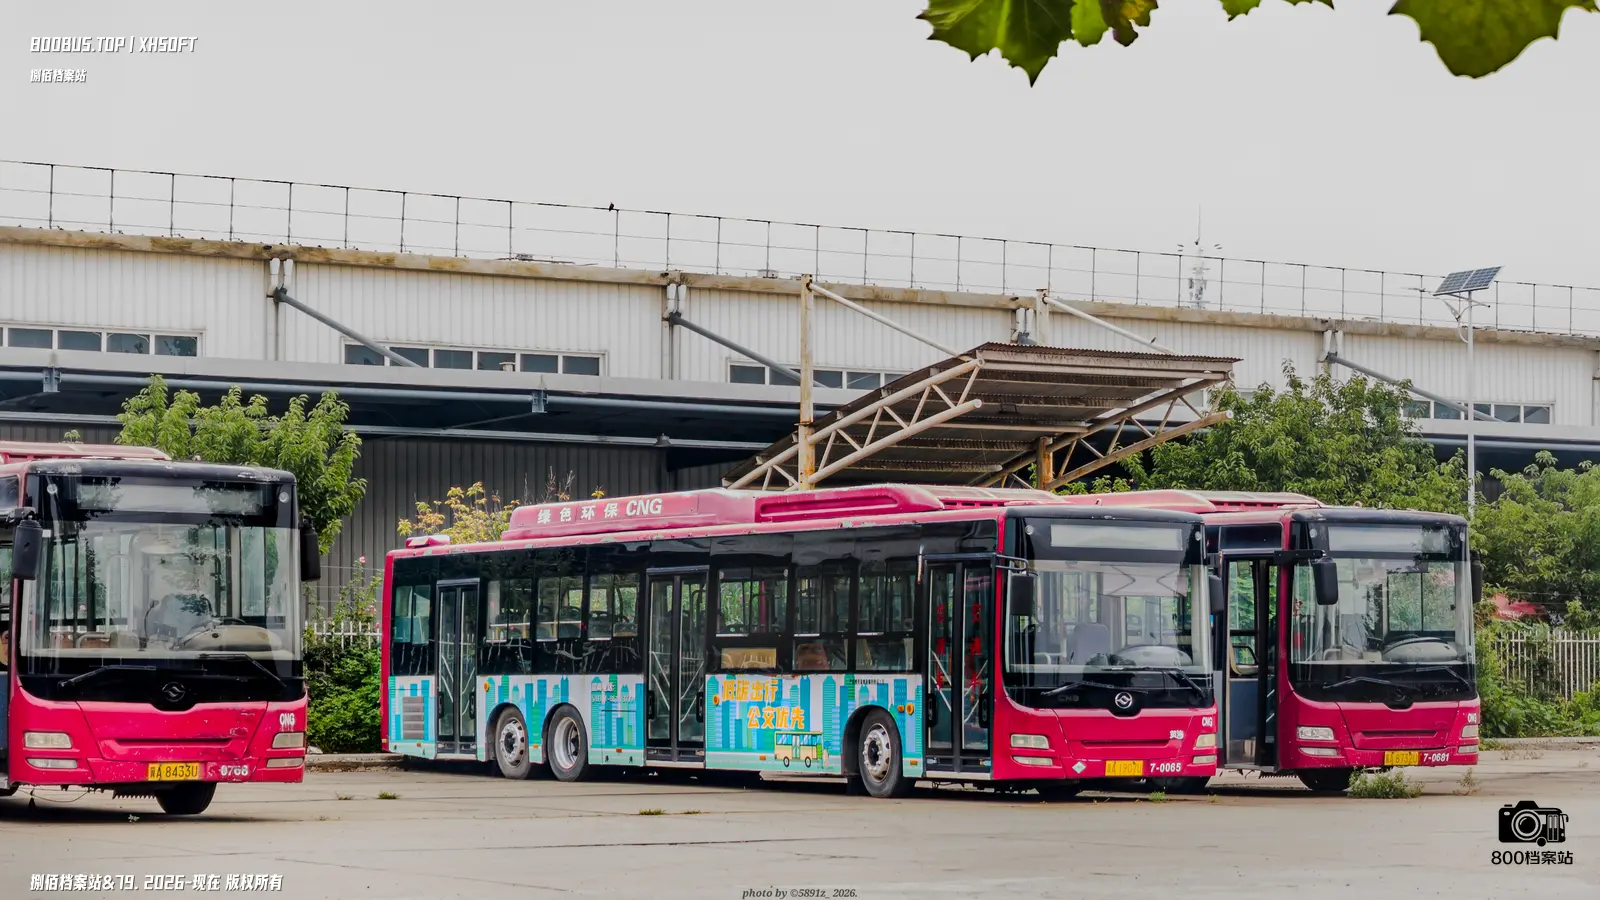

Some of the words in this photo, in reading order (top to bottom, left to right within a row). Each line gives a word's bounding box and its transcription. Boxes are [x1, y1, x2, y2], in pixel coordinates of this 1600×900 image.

[626, 497, 662, 517] CNG
[722, 679, 778, 702] 低碳出行
[747, 705, 805, 729] 公交优先
[1150, 762, 1182, 773] 7-0065
